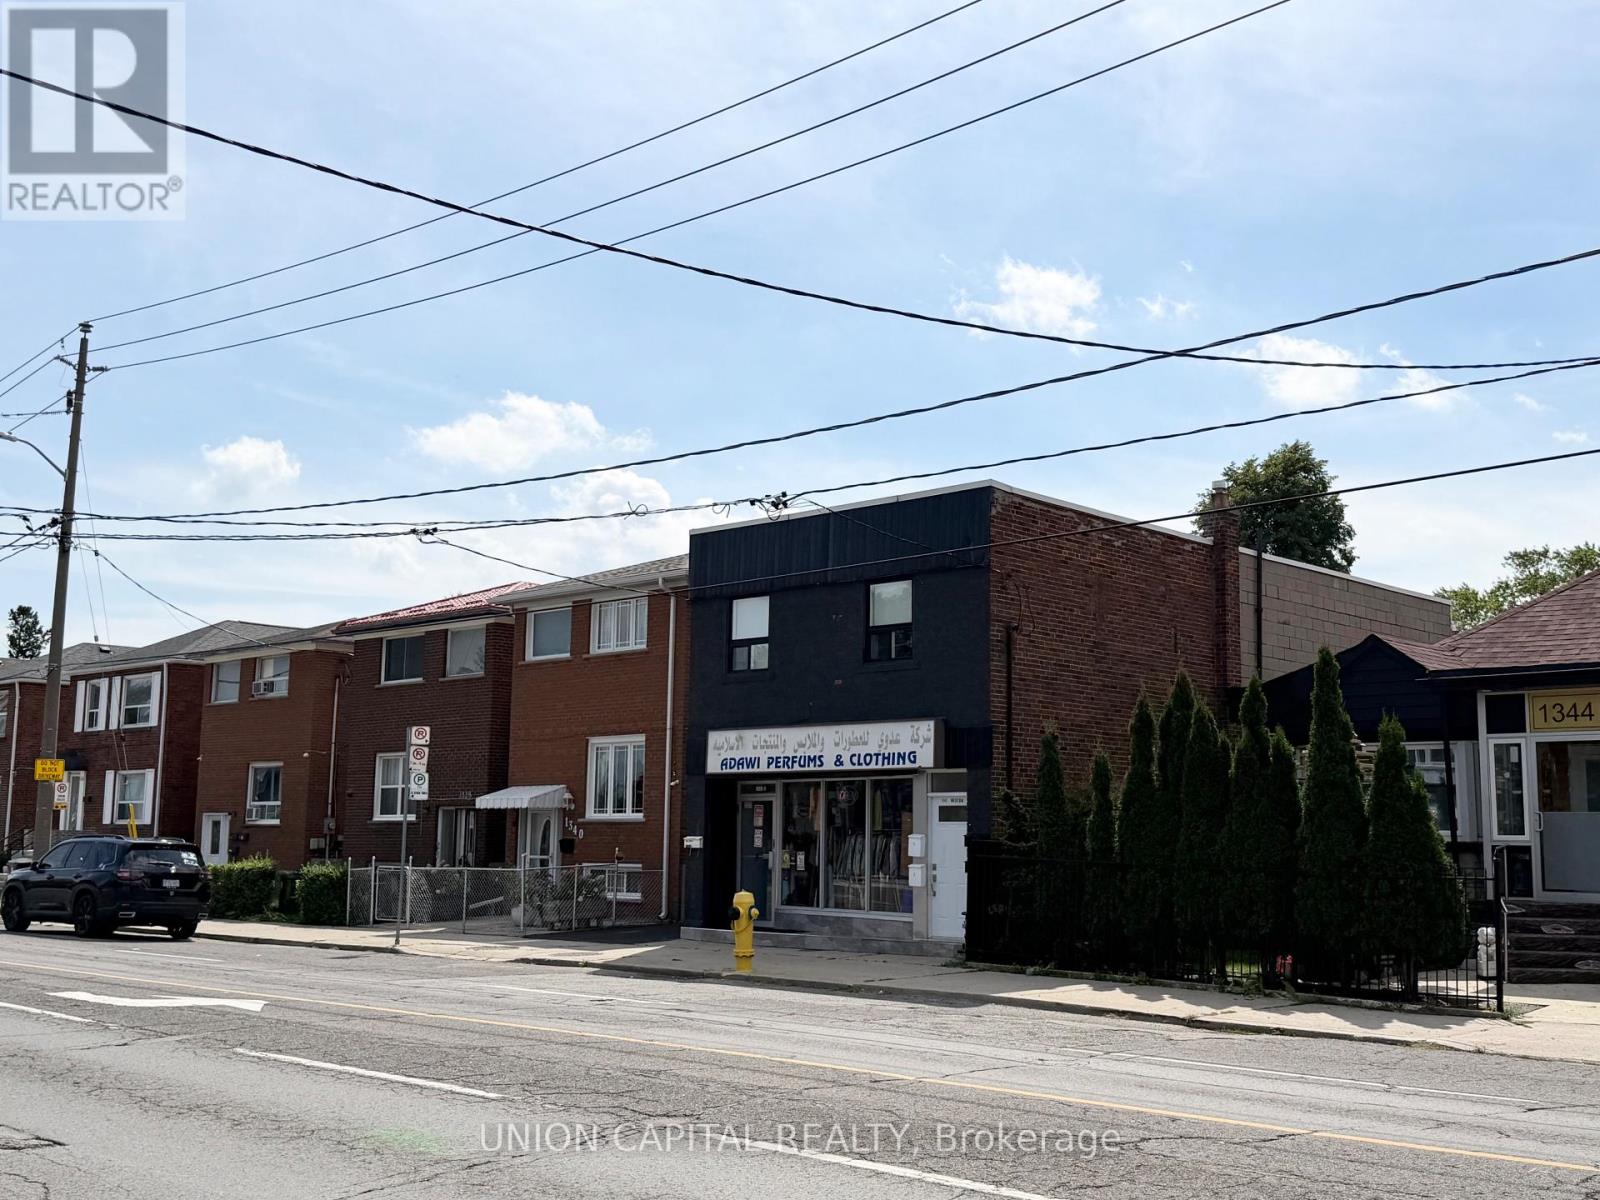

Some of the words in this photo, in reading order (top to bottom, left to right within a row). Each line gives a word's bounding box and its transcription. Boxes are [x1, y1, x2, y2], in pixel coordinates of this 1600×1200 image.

[1538, 701, 1595, 723] 1344
[910, 723, 932, 750] شركة
[720, 756, 760, 771] ADAWI
[767, 754, 825, 770] PERFUMS
[834, 754, 845, 767] &
[849, 751, 917, 767] CLOTHING
[565, 816, 584, 839] 1340
